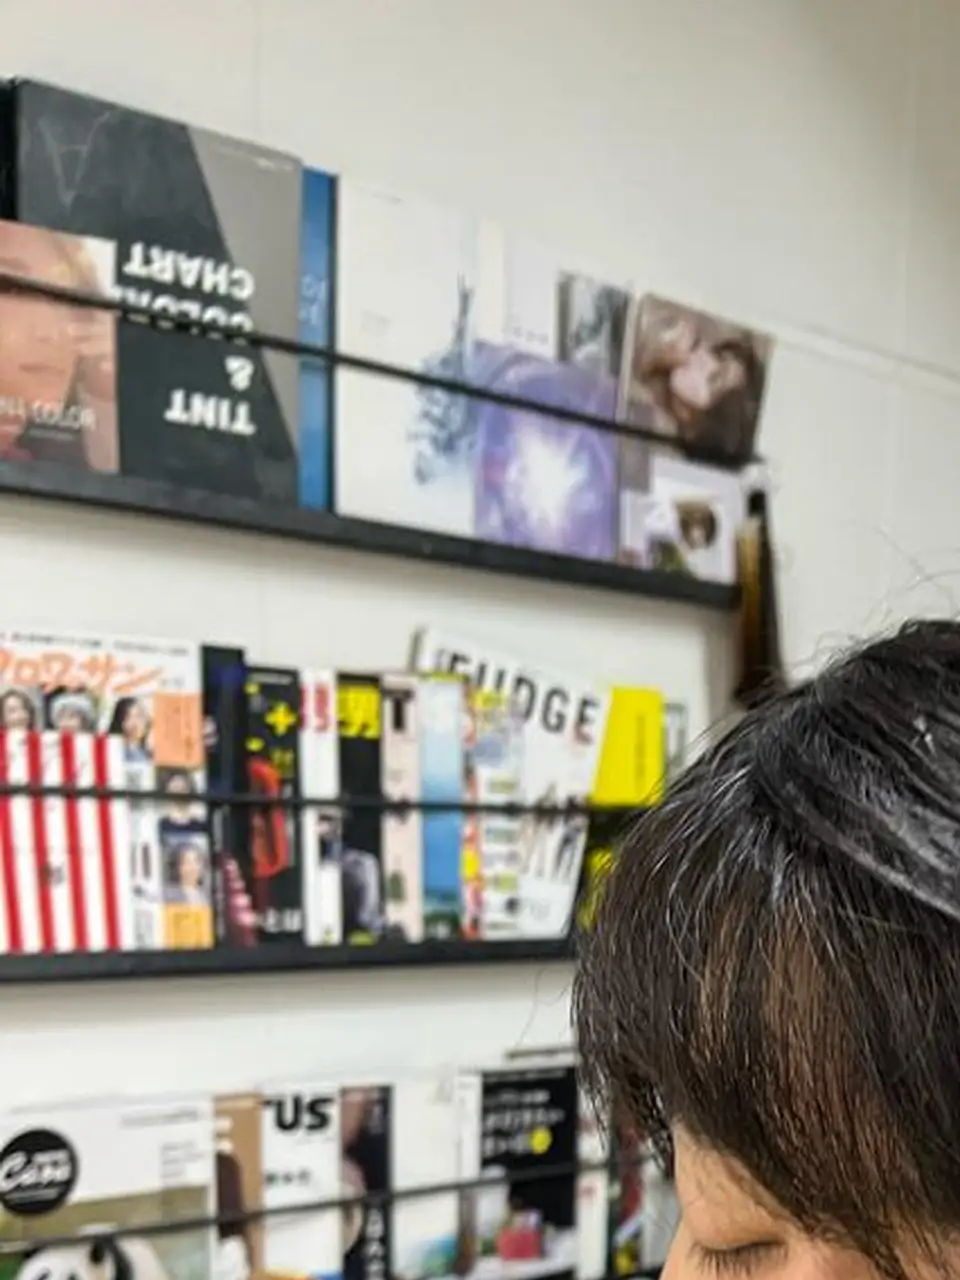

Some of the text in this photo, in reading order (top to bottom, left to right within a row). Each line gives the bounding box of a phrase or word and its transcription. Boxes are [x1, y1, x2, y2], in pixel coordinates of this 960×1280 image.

[124, 242, 255, 300] CHART
[225, 355, 255, 391] &
[164, 389, 256, 435] TINT
